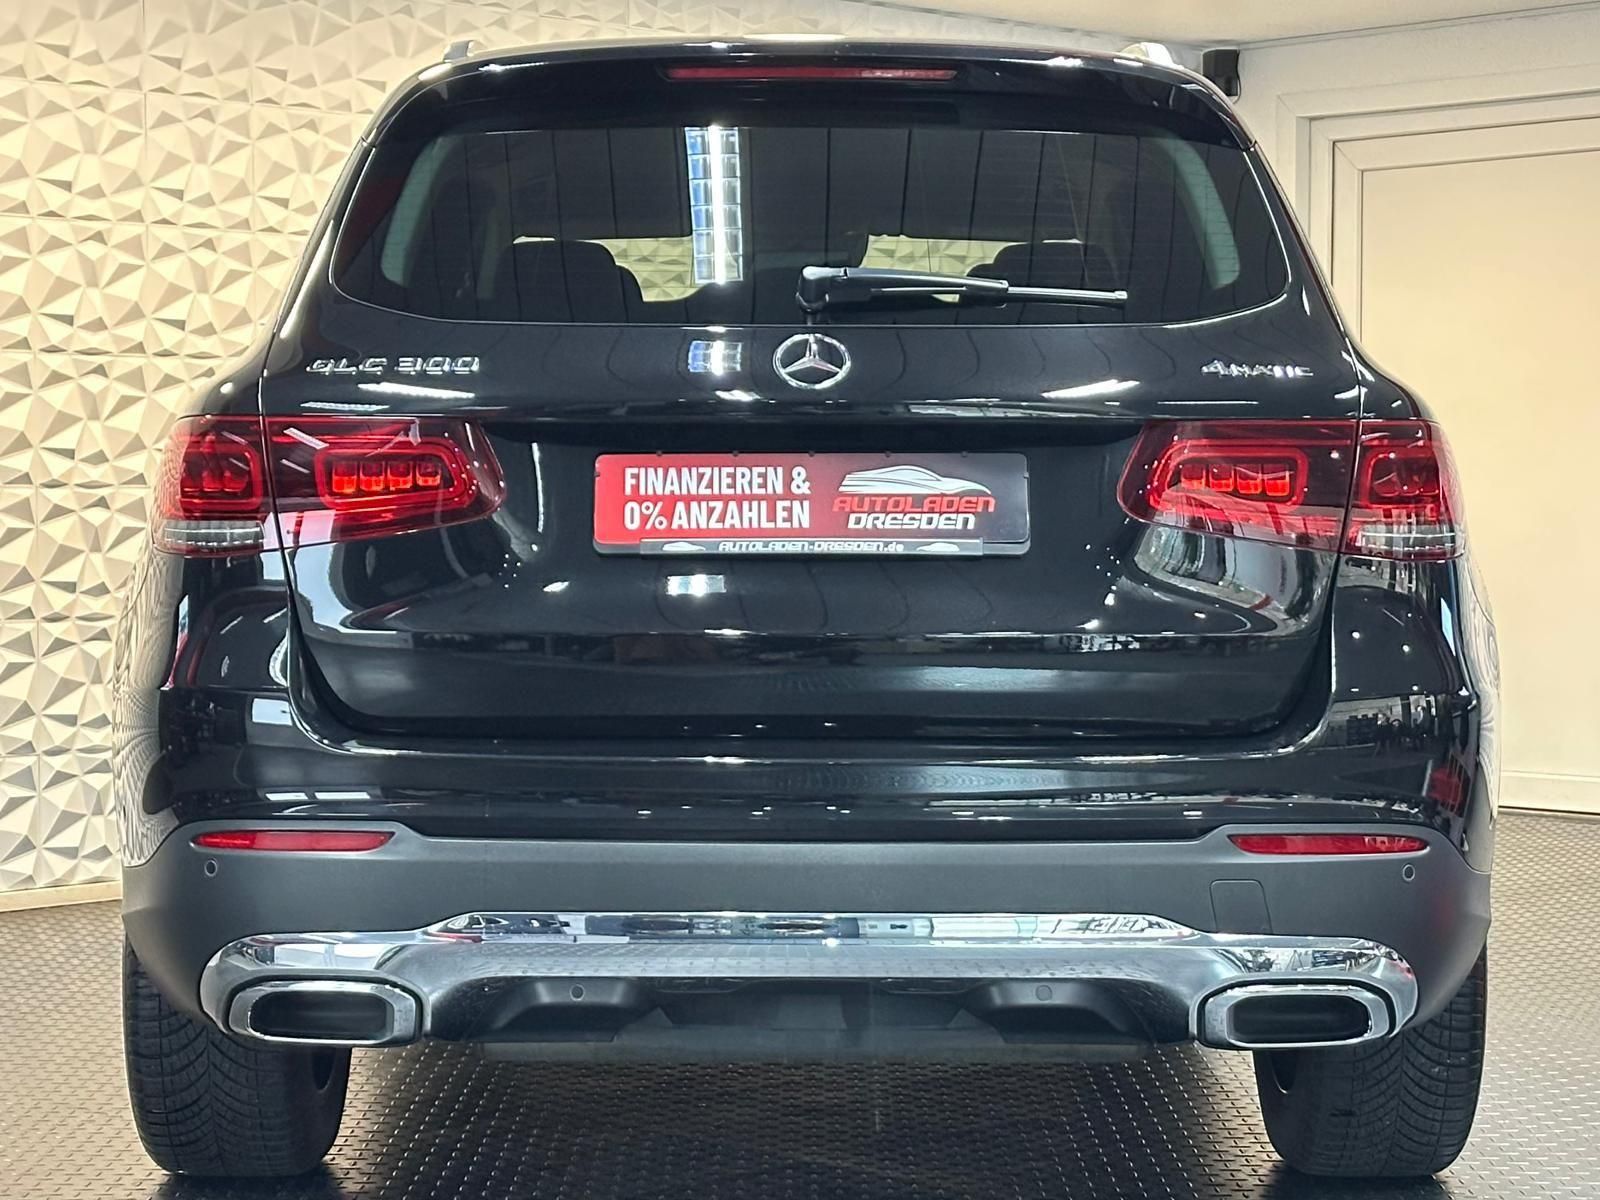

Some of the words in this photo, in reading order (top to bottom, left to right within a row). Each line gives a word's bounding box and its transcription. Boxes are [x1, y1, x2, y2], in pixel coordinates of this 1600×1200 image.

[306, 357, 388, 375] GLC
[394, 357, 480, 375] 300
[1201, 359, 1314, 378] 4MATIC
[624, 466, 784, 495] FINANZIEREN
[790, 466, 811, 495] &
[832, 496, 996, 512] AUTOLADEN
[624, 500, 668, 530] 0%
[671, 500, 811, 529] ANZAHLEN
[847, 513, 976, 530] DRESDEN
